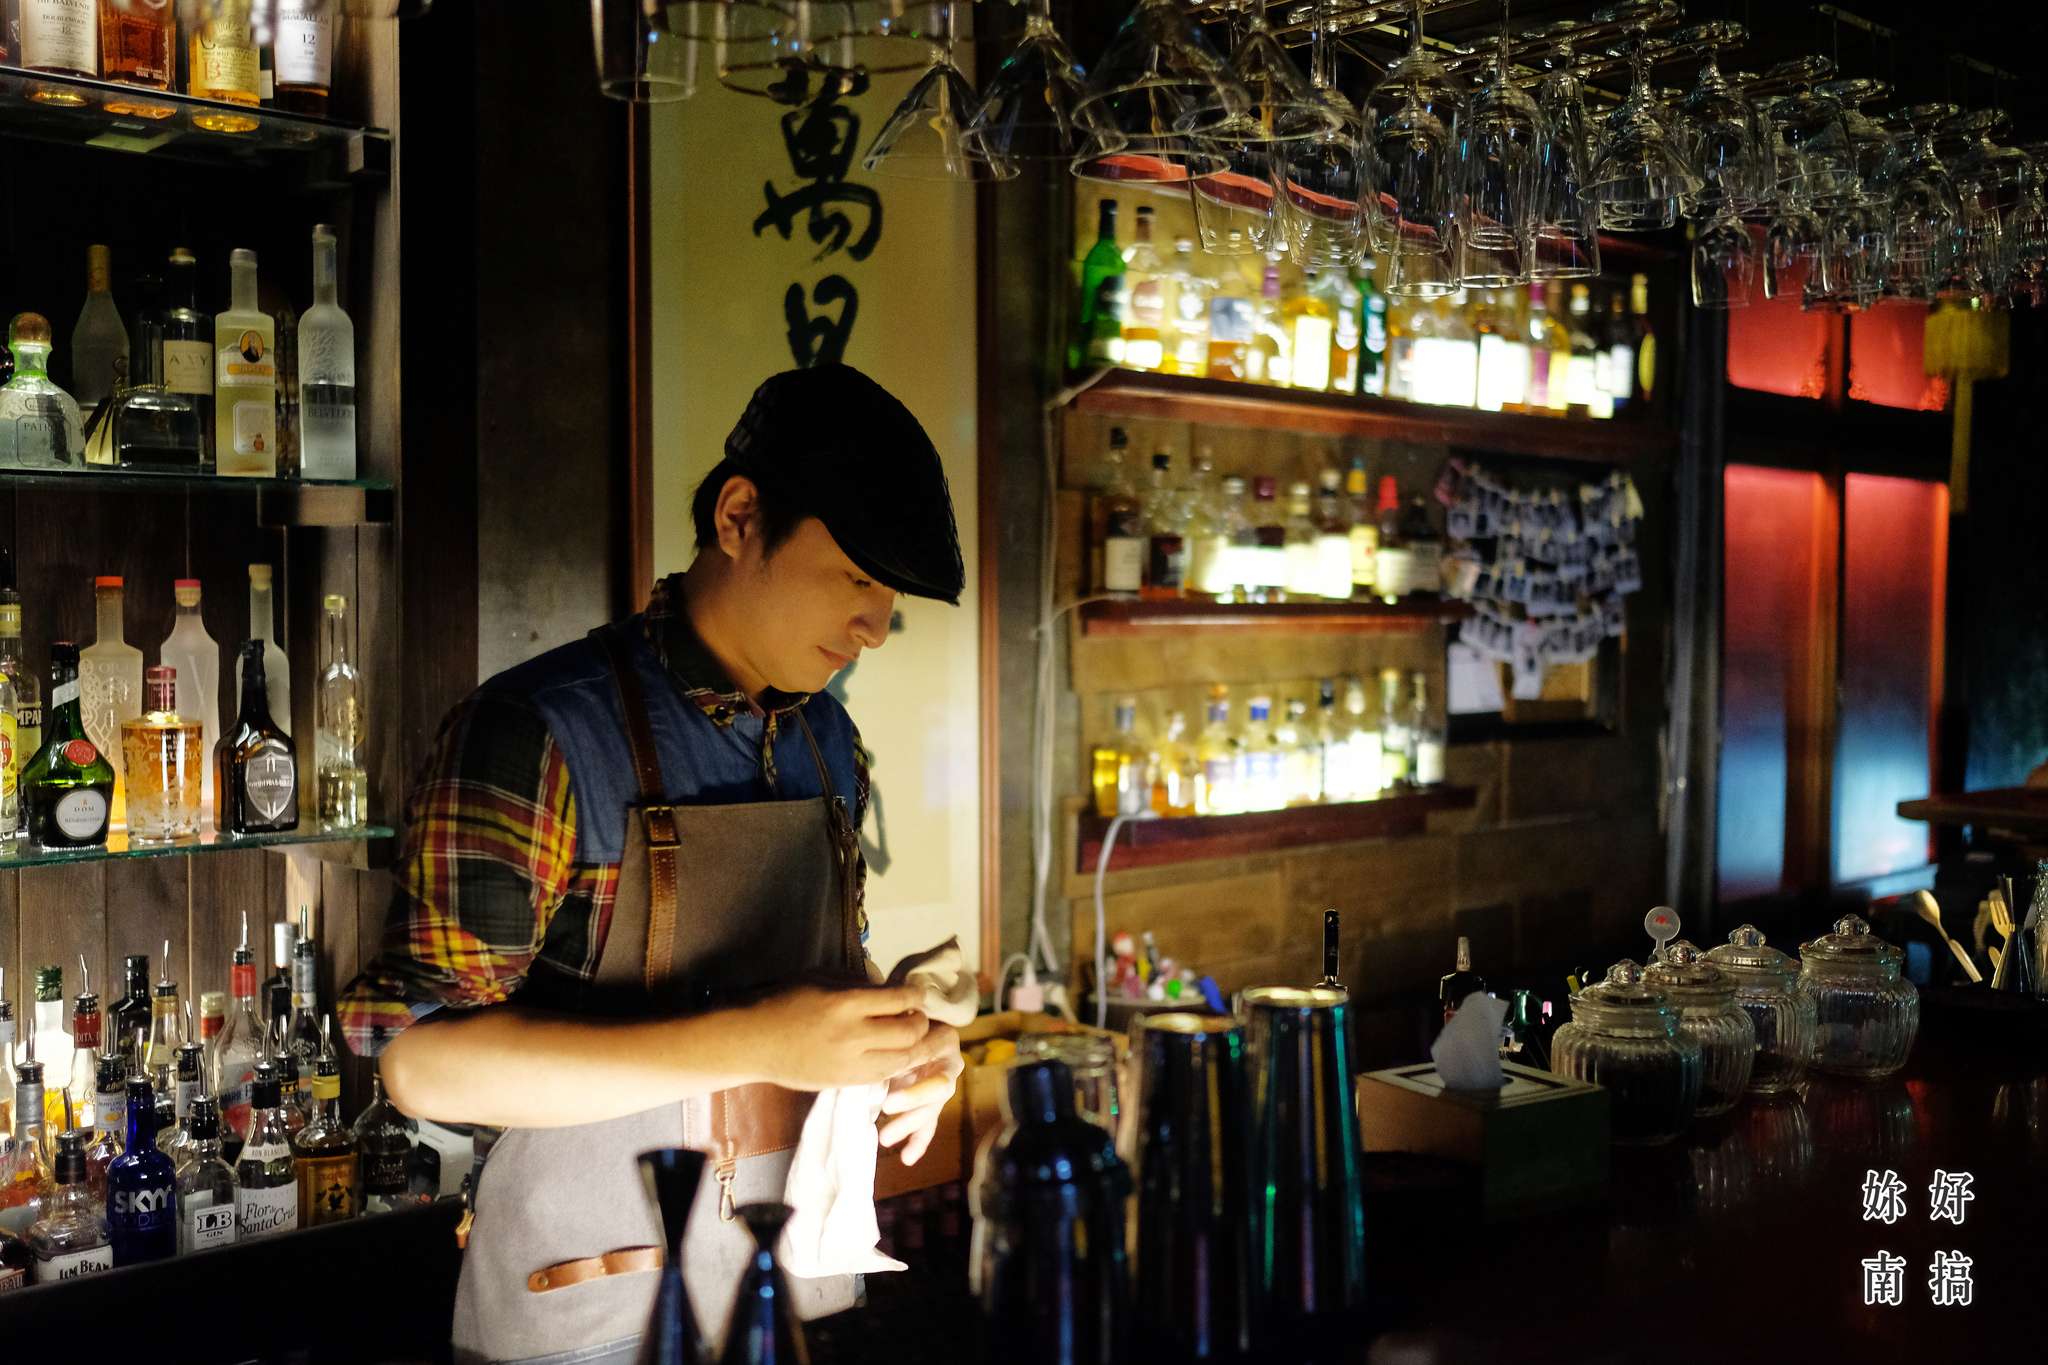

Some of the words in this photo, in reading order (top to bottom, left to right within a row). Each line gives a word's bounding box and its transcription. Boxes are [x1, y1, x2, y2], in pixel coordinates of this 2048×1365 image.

[303, 33, 316, 45] 12
[114, 1185, 171, 1214] SKYY
[246, 1202, 271, 1220] Flor
[197, 1211, 232, 1233] LB
